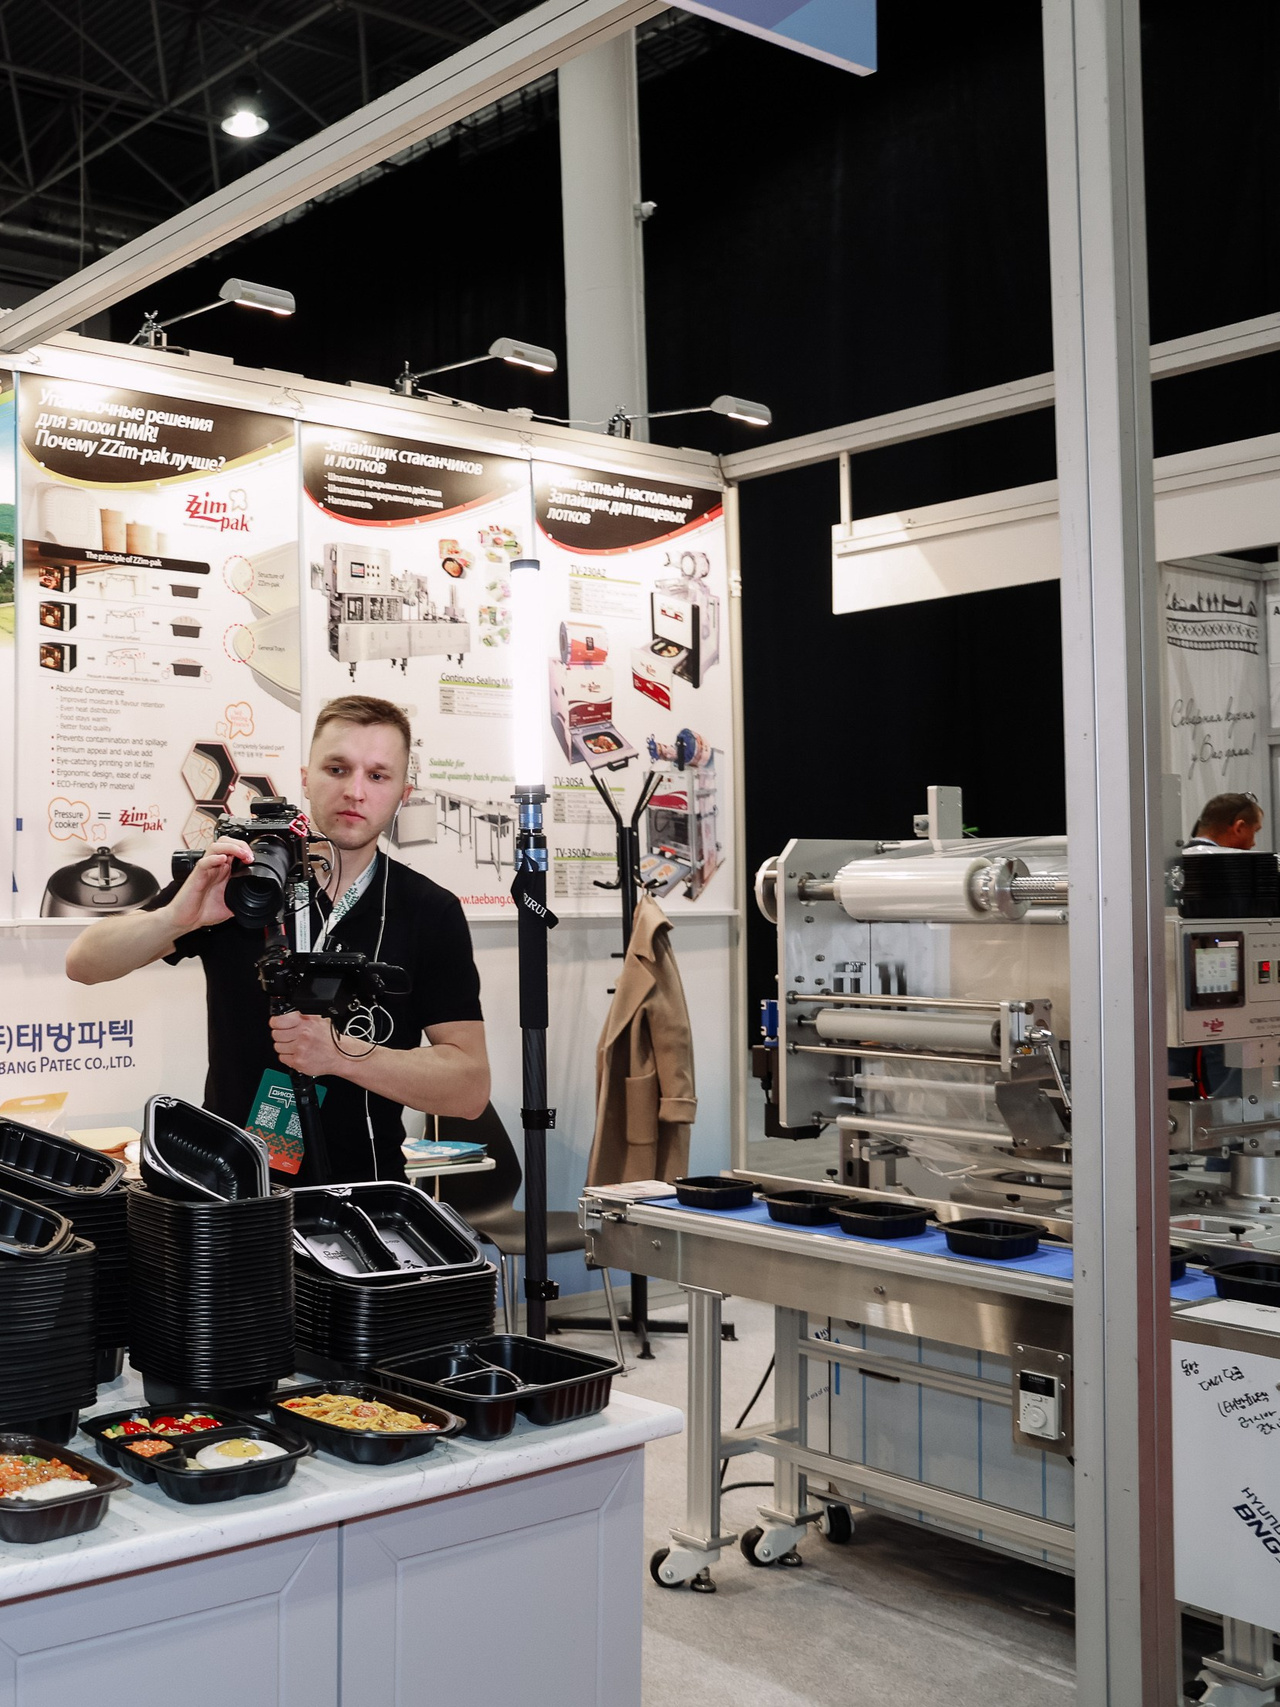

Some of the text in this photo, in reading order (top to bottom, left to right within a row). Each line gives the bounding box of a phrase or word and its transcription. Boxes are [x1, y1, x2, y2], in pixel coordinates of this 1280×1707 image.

[35, 412, 160, 443] для эпохи HMR!
[145, 410, 214, 433] решения
[34, 429, 227, 472] Почему ZZim-pak лучше?
[323, 453, 388, 475] и лотков
[398, 449, 484, 476] стаканчиков
[548, 487, 687, 524] Запайщик для пищевых
[625, 488, 694, 510] настольный
[220, 514, 251, 533] pak
[546, 507, 592, 525] лотков
[84, 550, 99, 560] The
[98, 553, 125, 564] principle
[440, 672, 501, 686] Continuos Sealing
[55, 684, 125, 696] Absolute Convenience
[56, 733, 168, 749] Prevents contamination spillage
[56, 744, 154, 759] Premium appeal and value add
[56, 756, 156, 769] Eye-catching printing on lid film
[56, 768, 91, 778] Ergonomic
[91, 770, 116, 779] design,
[116, 772, 132, 780] ease
[140, 773, 152, 781] use
[447, 772, 472, 782] quantity
[56, 779, 136, 791] ECO-Friendly material
[54, 809, 85, 820] Pressure
[54, 820, 80, 830] cooker
[142, 818, 164, 833] pak
[40, 1056, 82, 1073] PATEC
[84, 1055, 137, 1071] CO.,LTD.
